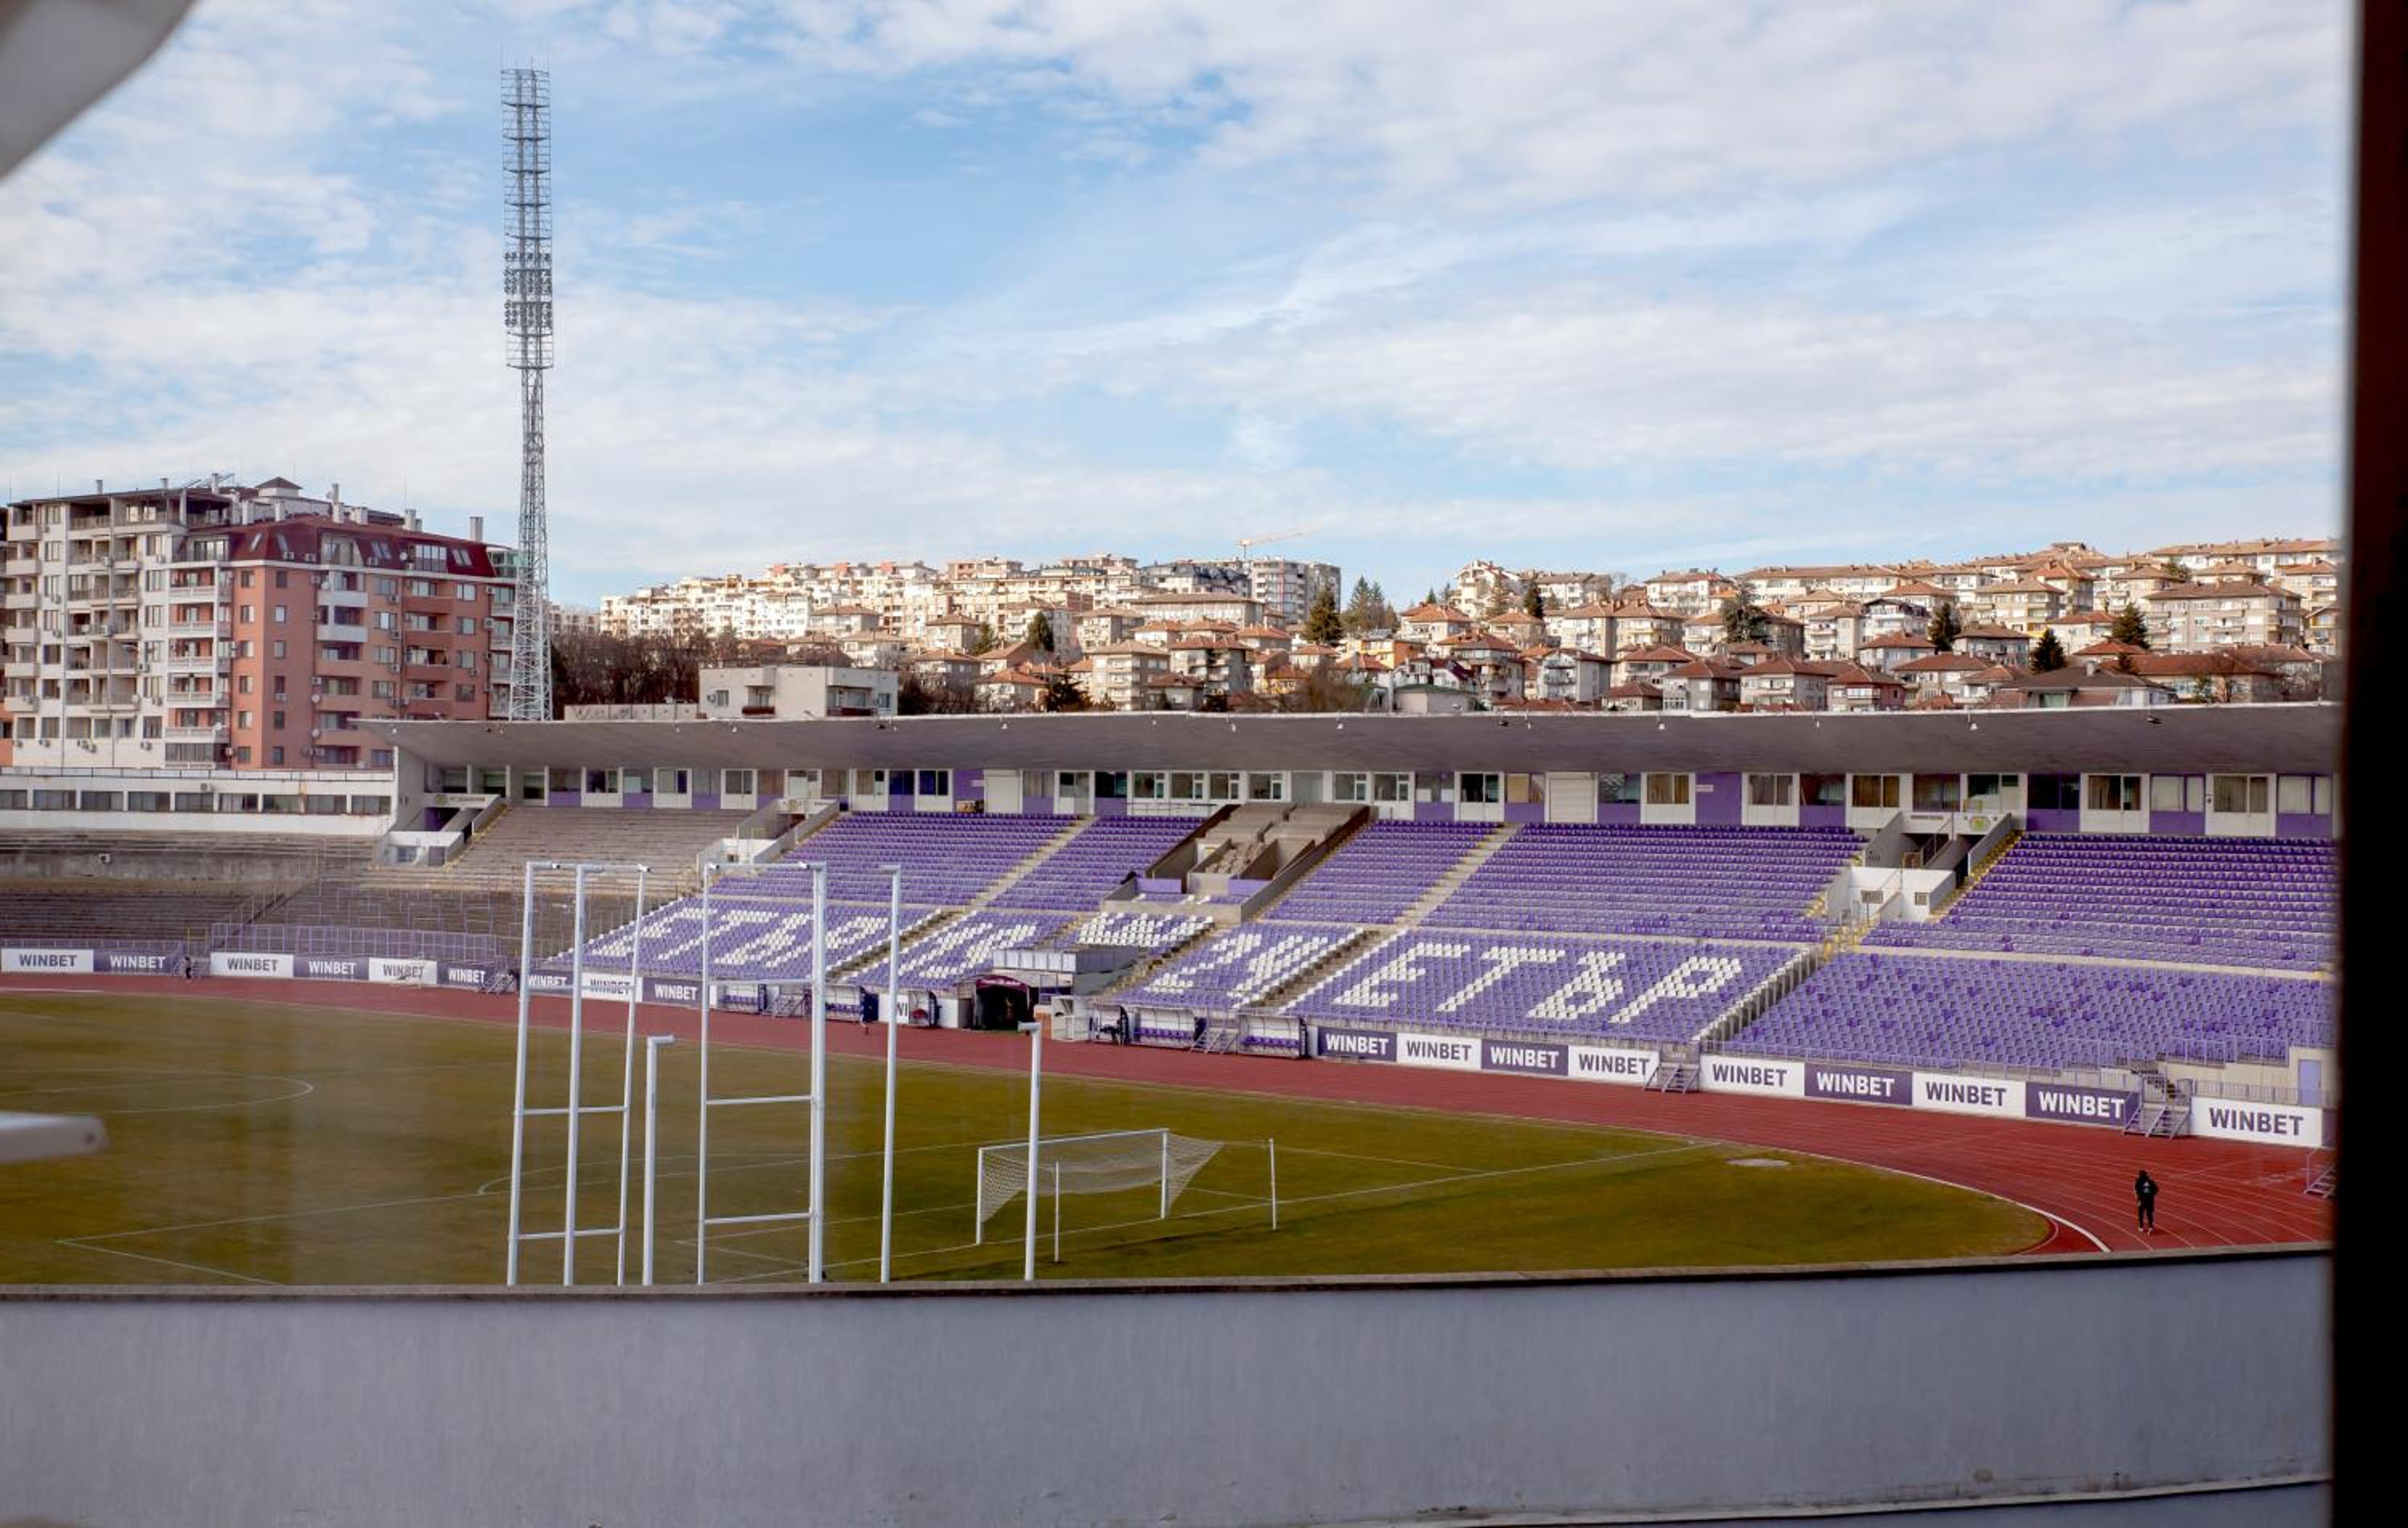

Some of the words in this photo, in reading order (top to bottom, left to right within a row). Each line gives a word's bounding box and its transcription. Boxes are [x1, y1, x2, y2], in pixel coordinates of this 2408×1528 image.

[18, 954, 78, 967] WINBET
[109, 955, 166, 969] WINBET
[226, 957, 279, 972] WINBET
[308, 961, 356, 975] WINBET
[383, 964, 425, 978] WINBET
[447, 967, 486, 983] WINBET
[654, 983, 698, 1001] WINBET
[1325, 1034, 1389, 1056] WINBET
[1406, 1039, 1472, 1062] WINBET
[1489, 1046, 1559, 1069] WINBET
[1578, 1053, 1649, 1076] WINBET
[1711, 1063, 1788, 1088] WINBET
[1816, 1071, 1895, 1098] WINBET
[1926, 1081, 2007, 1107] WINBET
[2038, 1090, 2125, 1119] WINBET
[2209, 1107, 2304, 1136] WINBET
